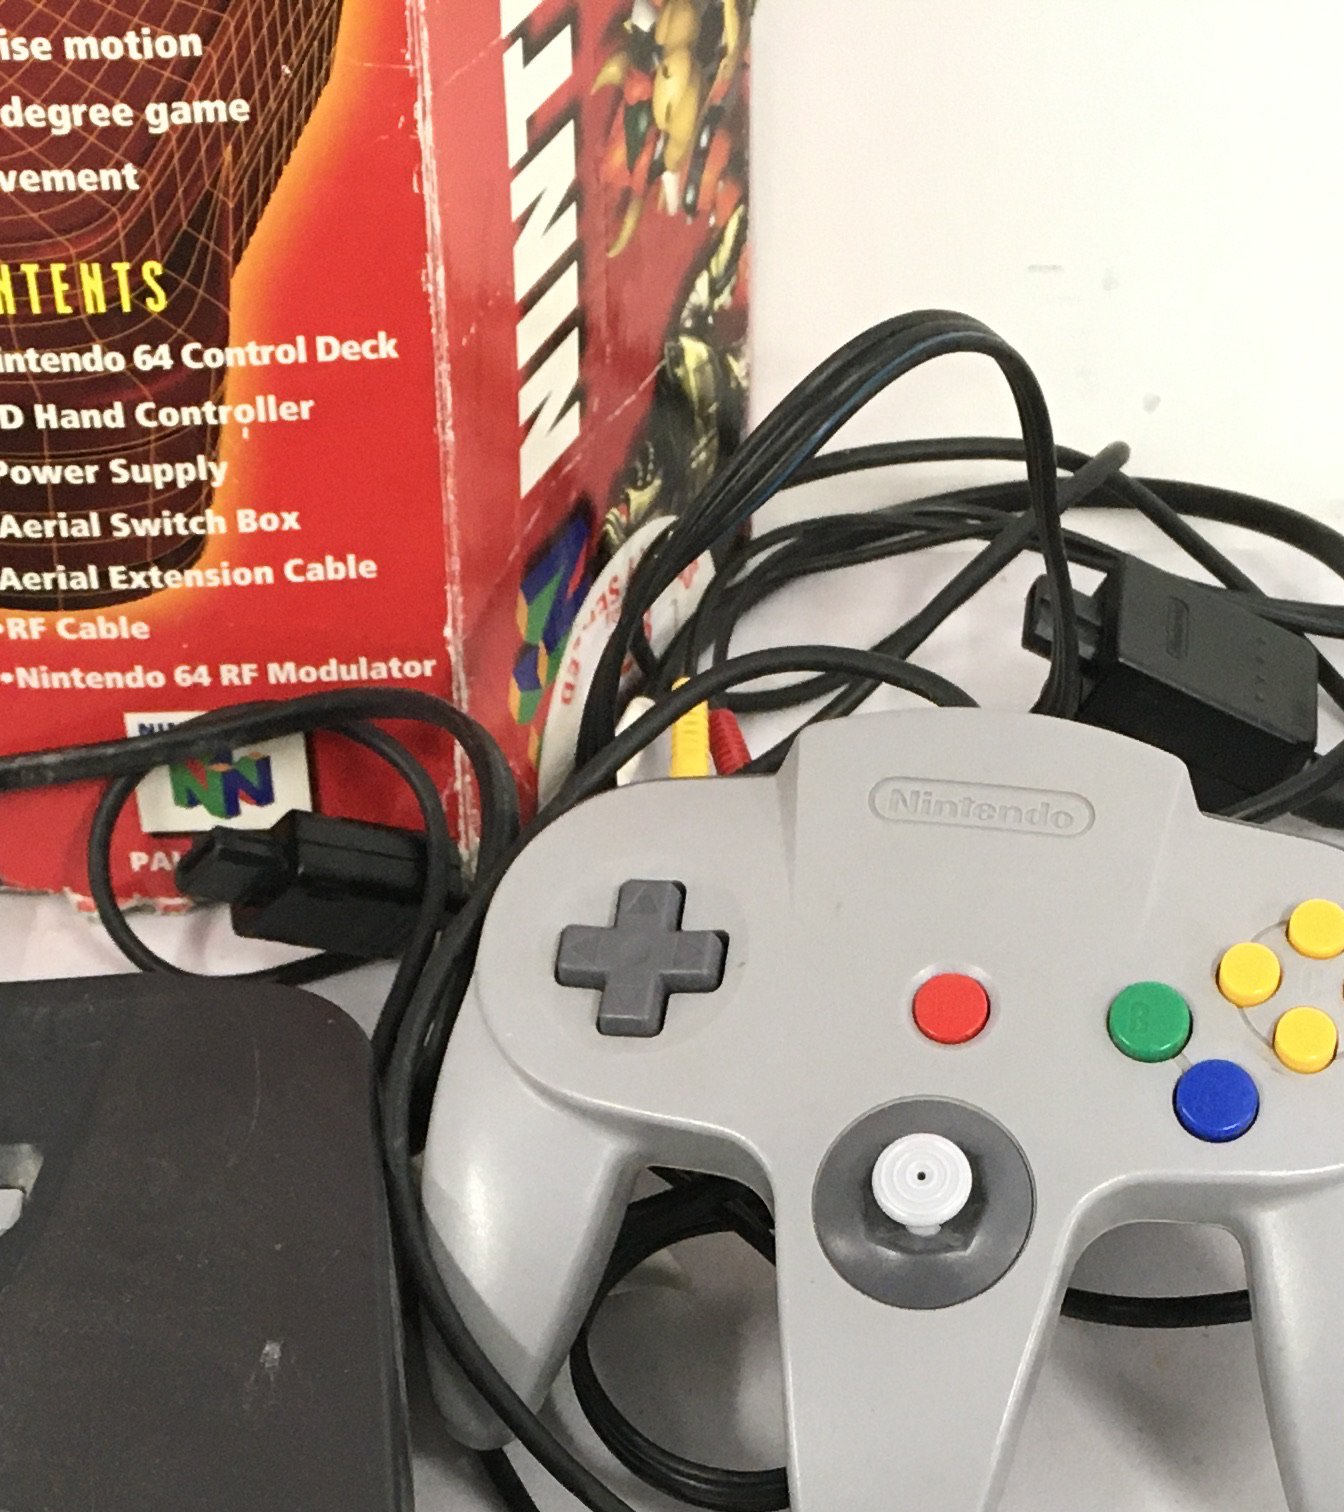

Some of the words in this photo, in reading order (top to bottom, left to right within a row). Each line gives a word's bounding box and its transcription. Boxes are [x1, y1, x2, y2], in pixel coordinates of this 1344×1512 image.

[64, 27, 203, 61] motion
[0, 96, 134, 136] degree
[144, 98, 251, 134] game
[132, 344, 173, 372] 64
[181, 335, 307, 369] Control
[315, 331, 399, 361] Deck
[34, 401, 125, 430] Hand
[135, 395, 315, 428] Controller
[109, 455, 228, 489] Supply
[110, 508, 227, 538] Switch
[236, 508, 301, 534] Box
[108, 560, 275, 590] Extension
[284, 554, 379, 582] Cable
[6, 617, 47, 641] RF
[56, 616, 151, 641] Cable
[15, 664, 166, 690] Nintendo
[174, 665, 212, 687] 64
[220, 663, 259, 686] RF
[267, 656, 438, 685] Modulator
[888, 788, 1074, 829] Nintendo
